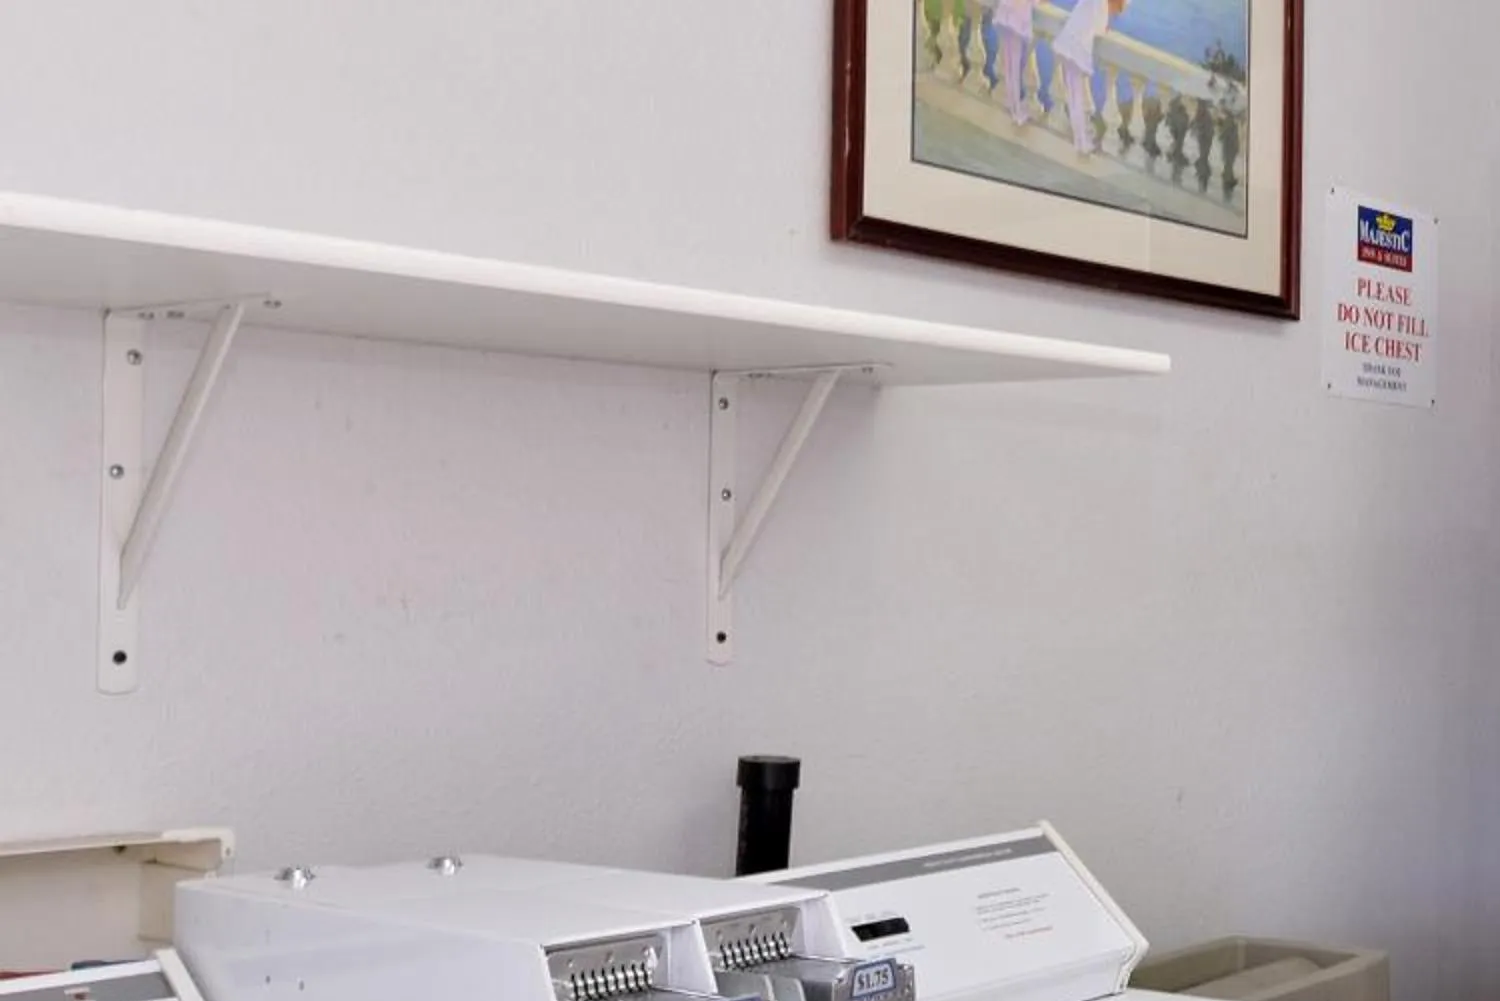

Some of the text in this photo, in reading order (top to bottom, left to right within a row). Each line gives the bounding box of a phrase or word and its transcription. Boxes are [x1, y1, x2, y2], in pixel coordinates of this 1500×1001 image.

[1359, 218, 1410, 253] MAJESTIC
[1357, 277, 1411, 306] PLEASE
[1337, 303, 1429, 337] DO NOT FILL
[1345, 331, 1421, 362] ICE CHEST
[857, 966, 889, 990] $1.75
